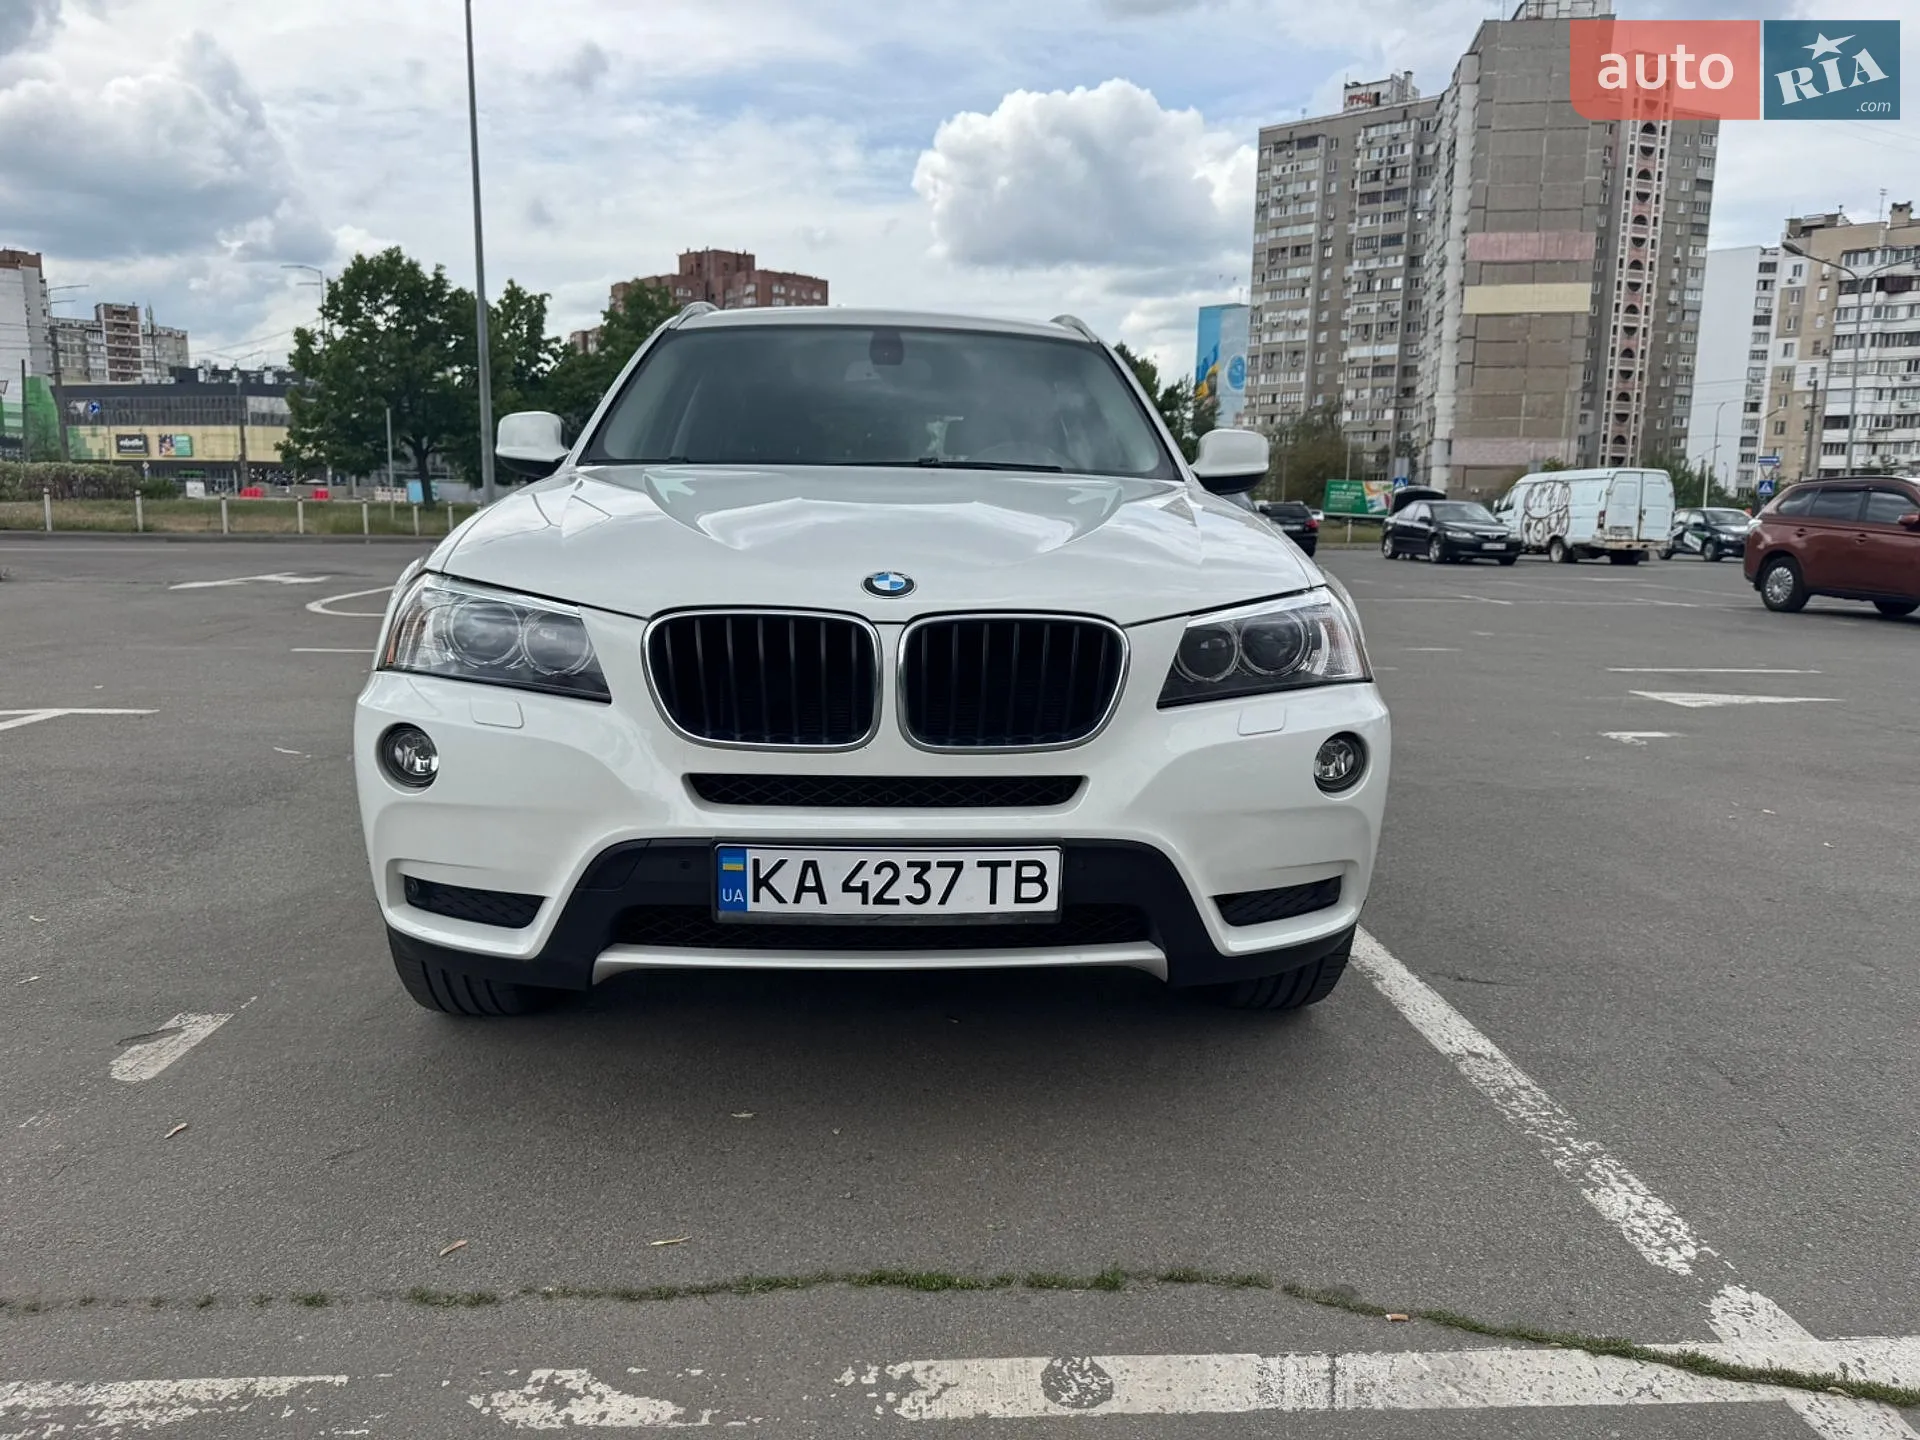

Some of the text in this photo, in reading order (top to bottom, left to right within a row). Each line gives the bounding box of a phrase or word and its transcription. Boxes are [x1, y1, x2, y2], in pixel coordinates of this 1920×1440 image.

[722, 888, 745, 903] UA
[752, 858, 1049, 906] KA 4237 TB
